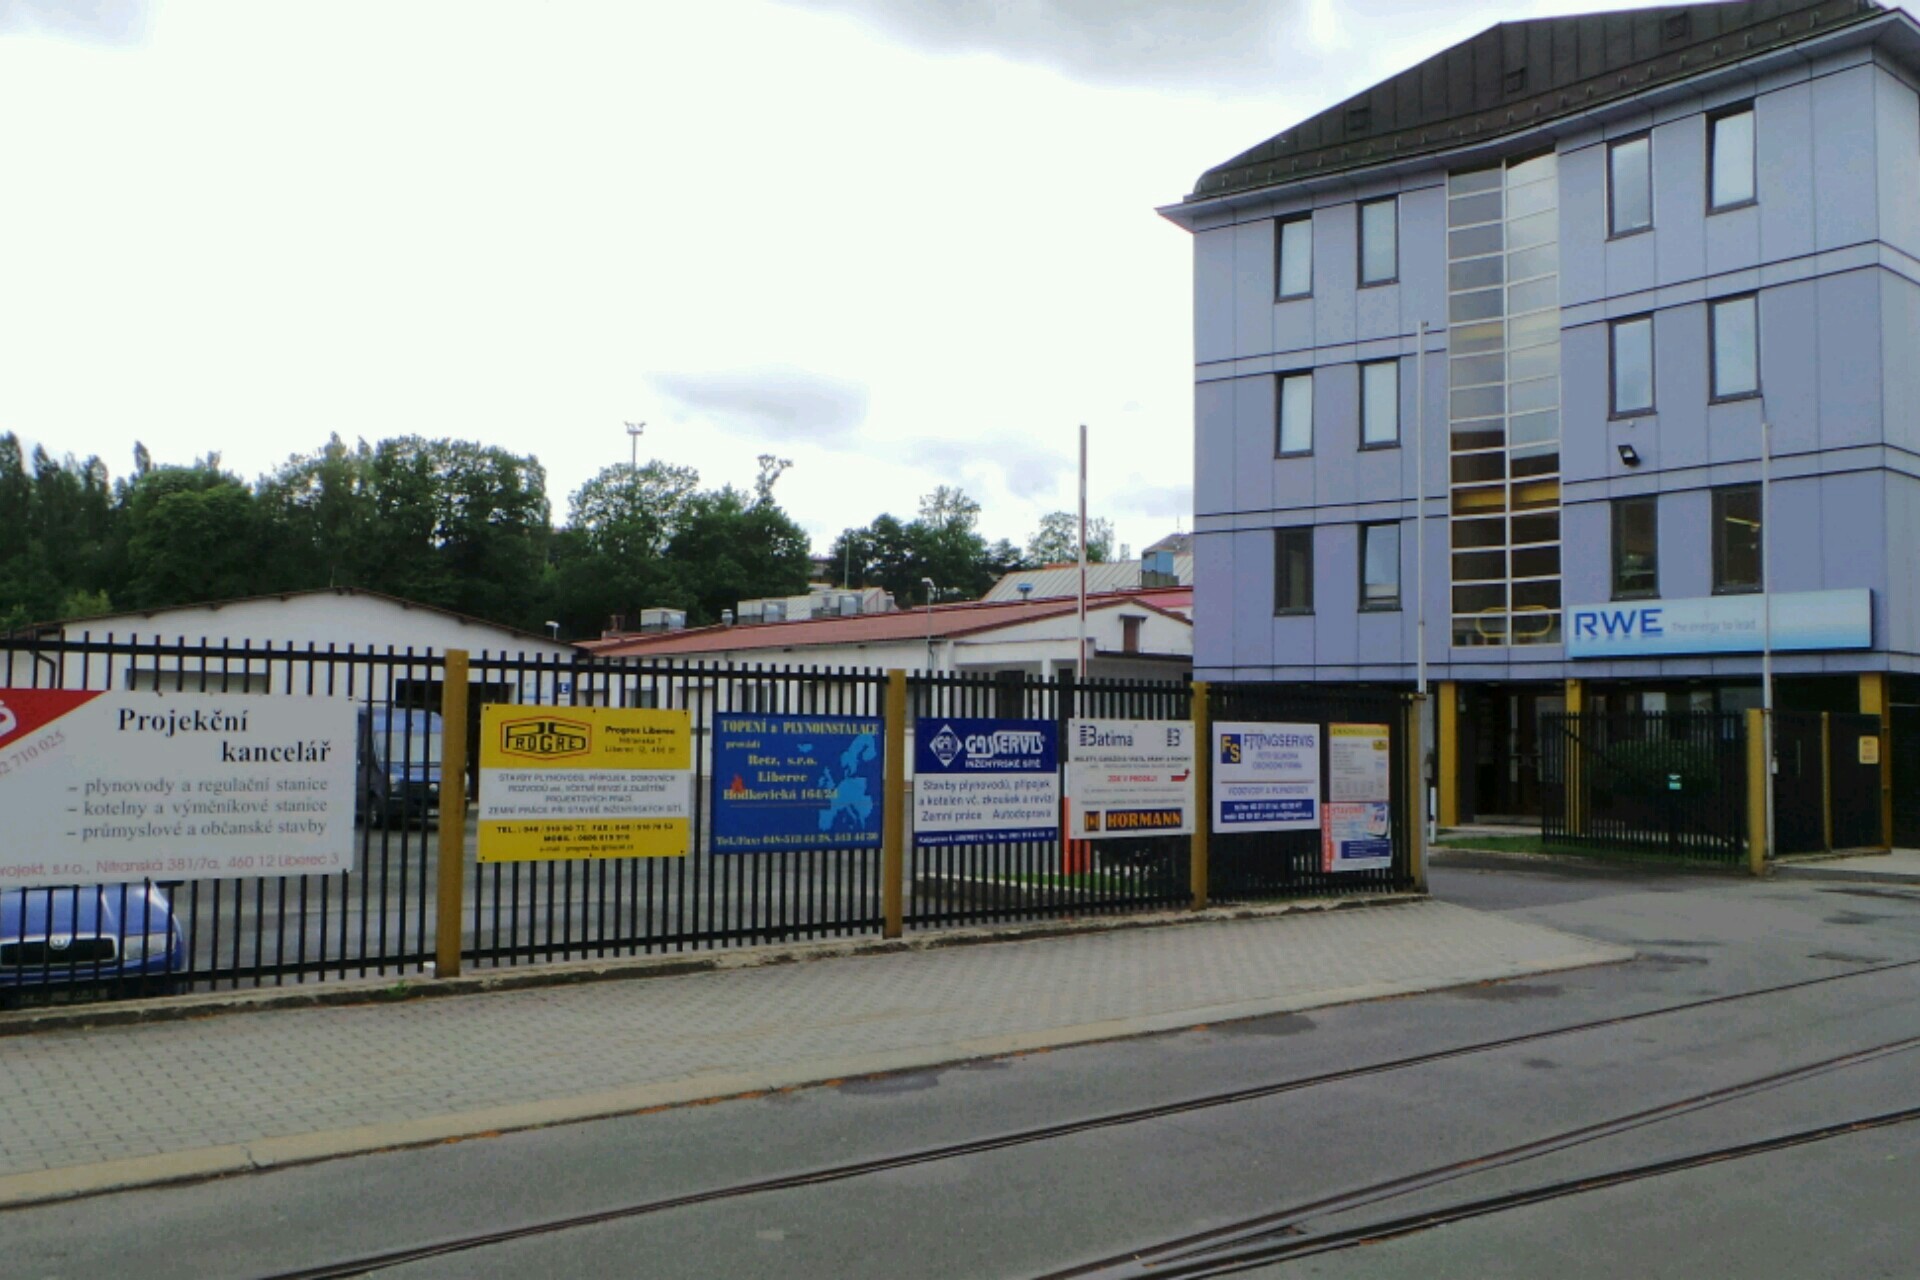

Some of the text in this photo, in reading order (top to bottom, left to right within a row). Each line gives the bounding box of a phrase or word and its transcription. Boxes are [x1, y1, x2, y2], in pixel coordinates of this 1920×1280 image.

[1575, 608, 1663, 636] RWE
[118, 707, 248, 737] Projekční
[721, 718, 767, 733] TOPENÍ
[1080, 725, 1133, 747] Batima
[222, 740, 331, 762] kancelář
[757, 770, 808, 783] Liberec
[923, 779, 957, 792] Stavby
[84, 778, 175, 797] plynovody
[181, 782, 192, 793] a
[198, 777, 270, 796] regulační
[276, 778, 328, 791] stanice
[723, 788, 797, 801] Hodkovická
[84, 801, 147, 818] kotelny
[154, 804, 164, 815] a
[173, 799, 269, 818] výměníkové
[276, 799, 328, 813] stanice
[921, 810, 952, 823] Zemní
[955, 810, 983, 823] práce
[82, 821, 182, 842] průmyslové
[187, 825, 197, 836] a
[201, 820, 273, 836] občanské
[278, 818, 327, 836] stavby
[0, 864, 46, 878] rojekt,
[228, 854, 254, 869] 460
[259, 854, 276, 868] 12
[278, 853, 327, 867] Liberec
[330, 852, 339, 865] 3
